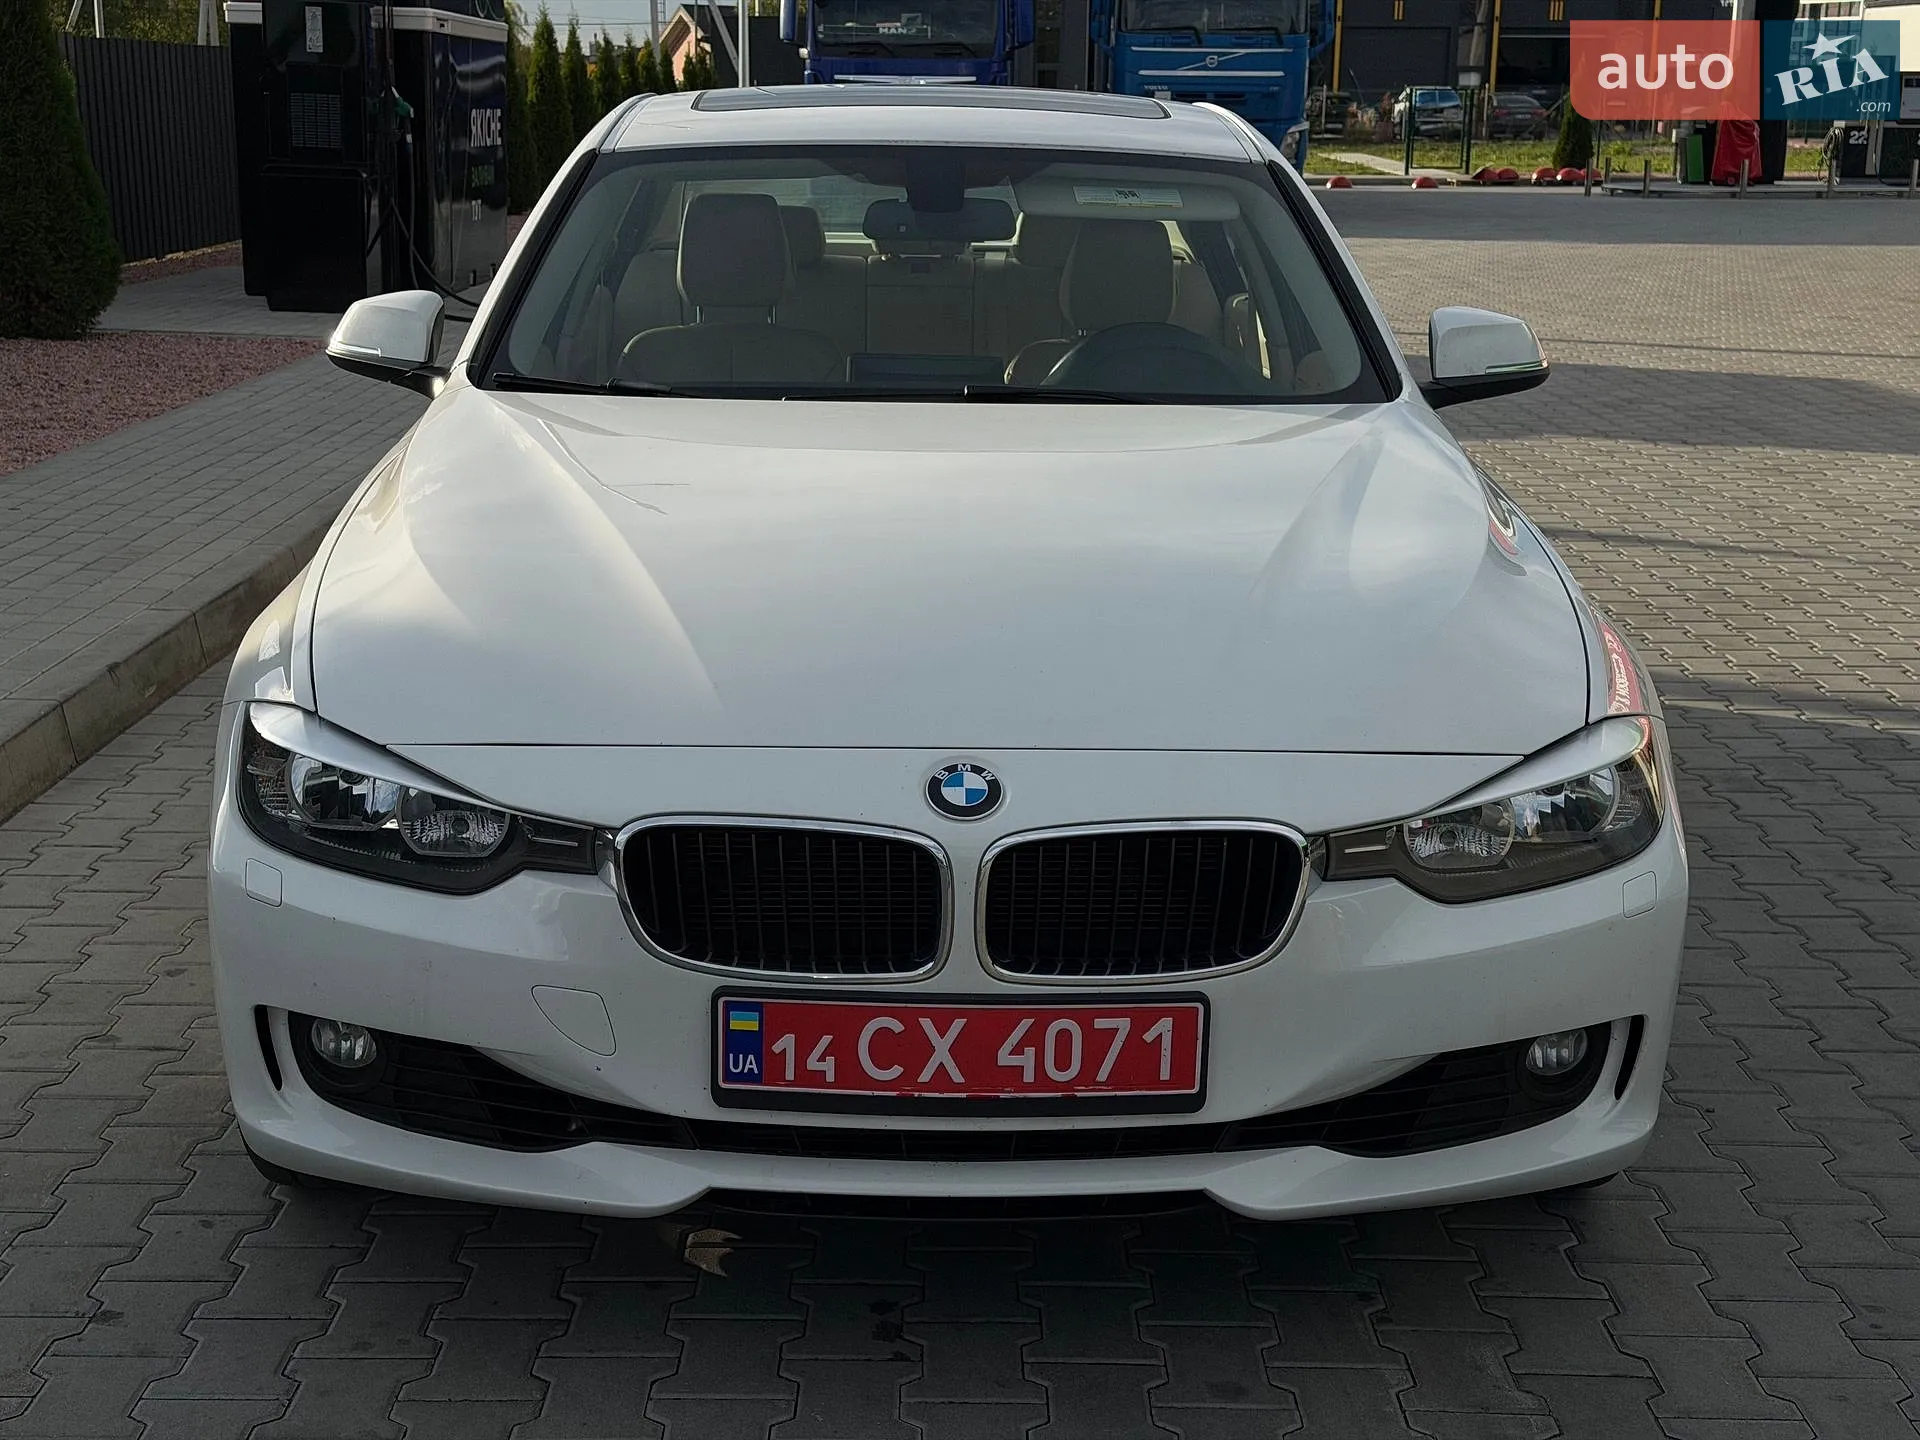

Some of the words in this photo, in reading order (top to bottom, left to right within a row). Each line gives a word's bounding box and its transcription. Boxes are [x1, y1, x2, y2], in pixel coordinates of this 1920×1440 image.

[934, 763, 996, 781] BMW
[771, 1034, 836, 1082] 14
[858, 1016, 968, 1084] CX
[997, 1016, 1174, 1083] 4071
[728, 1053, 759, 1074] UA
